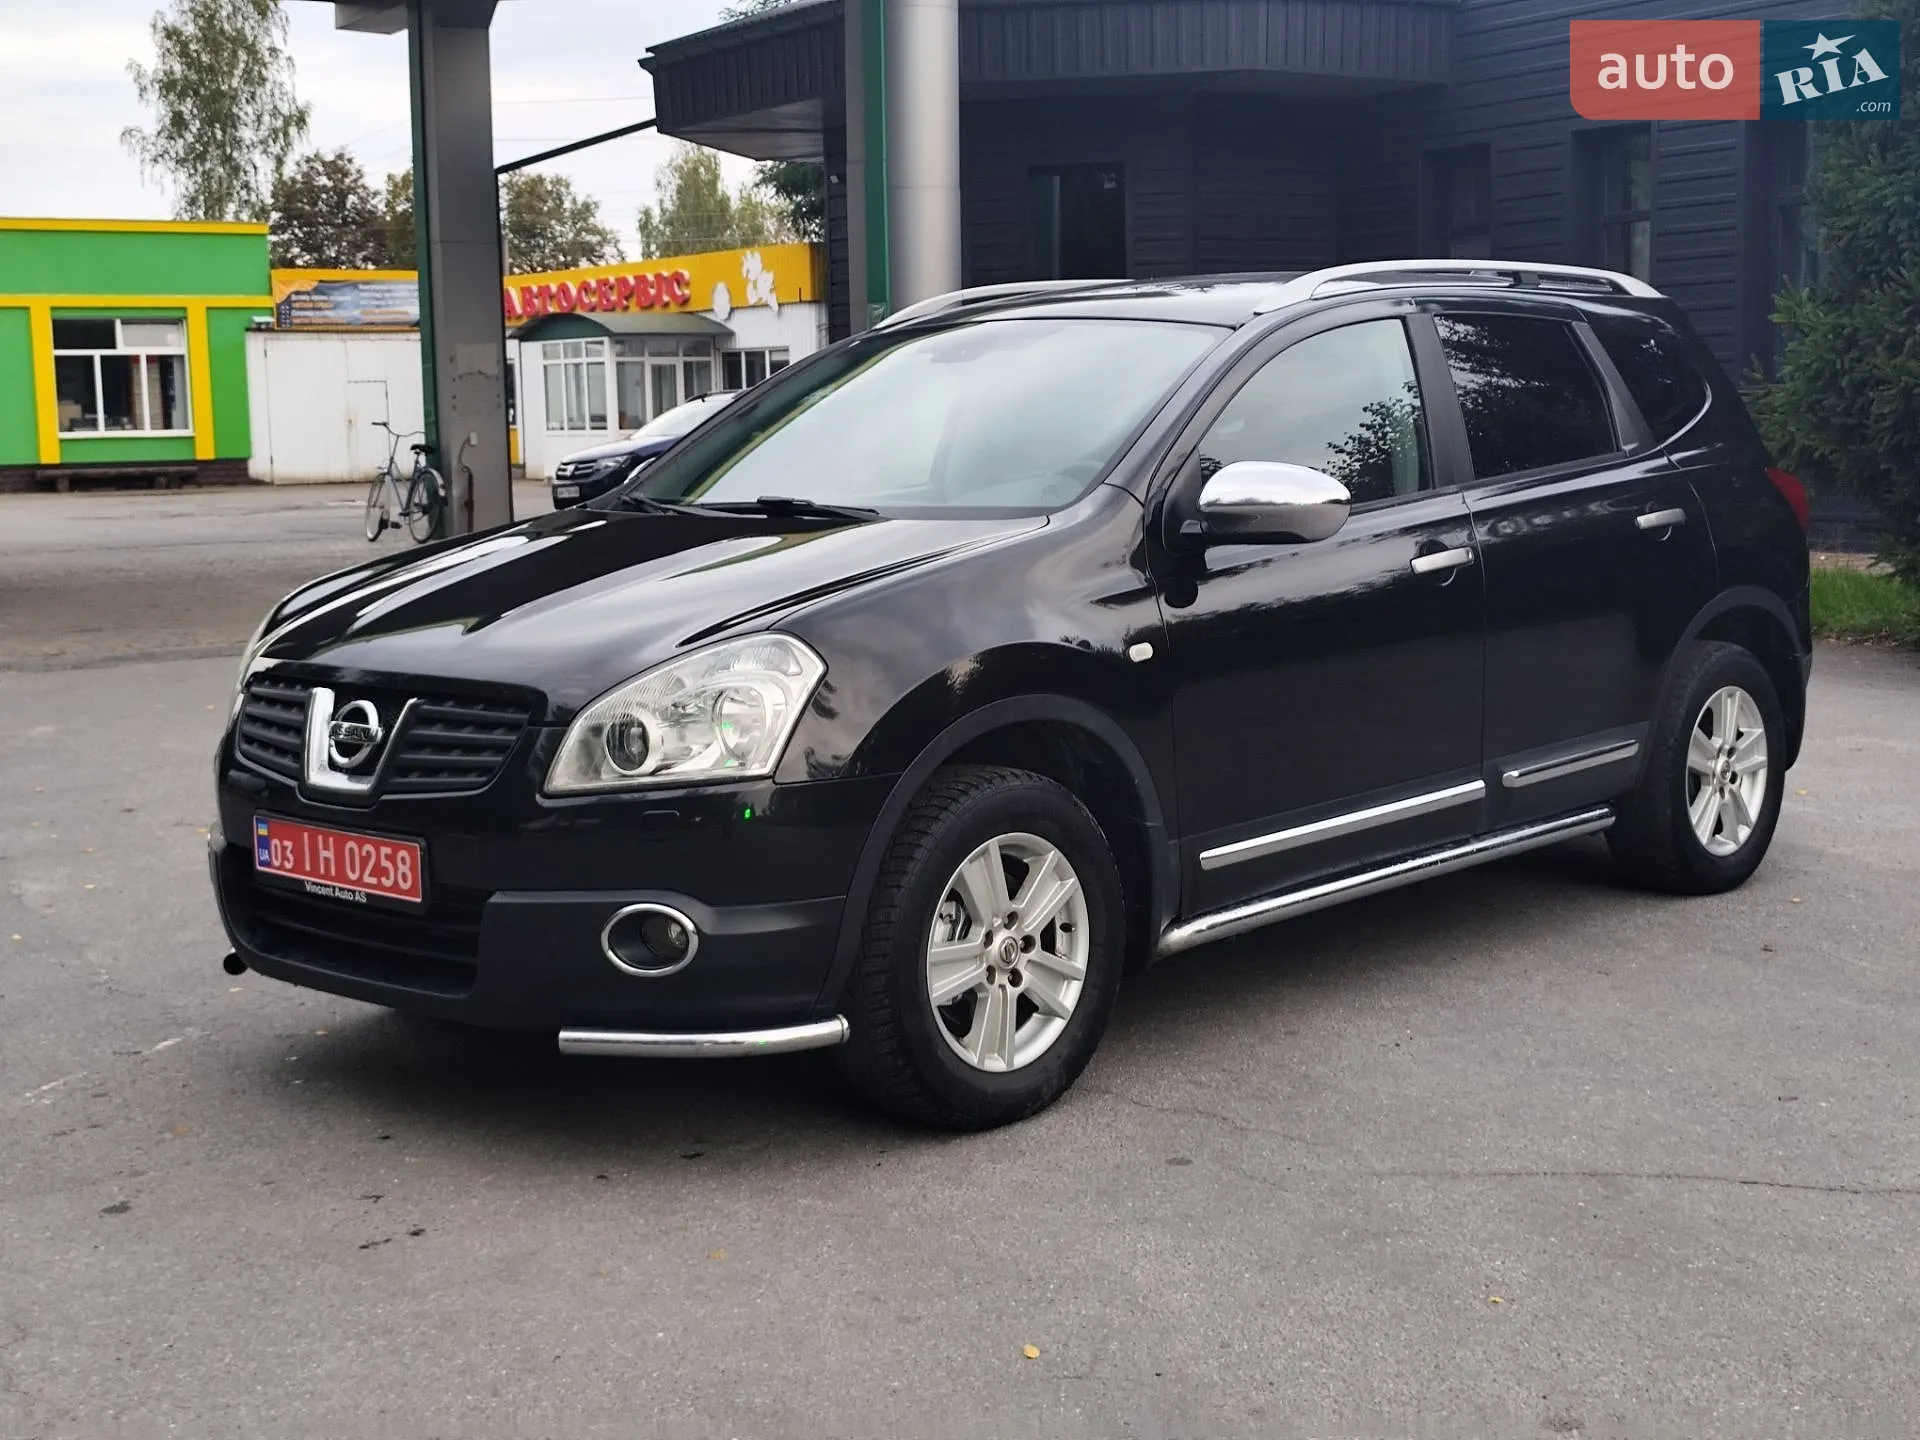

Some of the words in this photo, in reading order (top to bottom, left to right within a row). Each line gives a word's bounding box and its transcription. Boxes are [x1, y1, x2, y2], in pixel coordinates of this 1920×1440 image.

[504, 269, 691, 319] АВТОСЕРВІС
[271, 838, 294, 870] 03
[344, 840, 413, 890] 0258
[334, 886, 354, 901] Auto
[354, 890, 367, 903] AS
